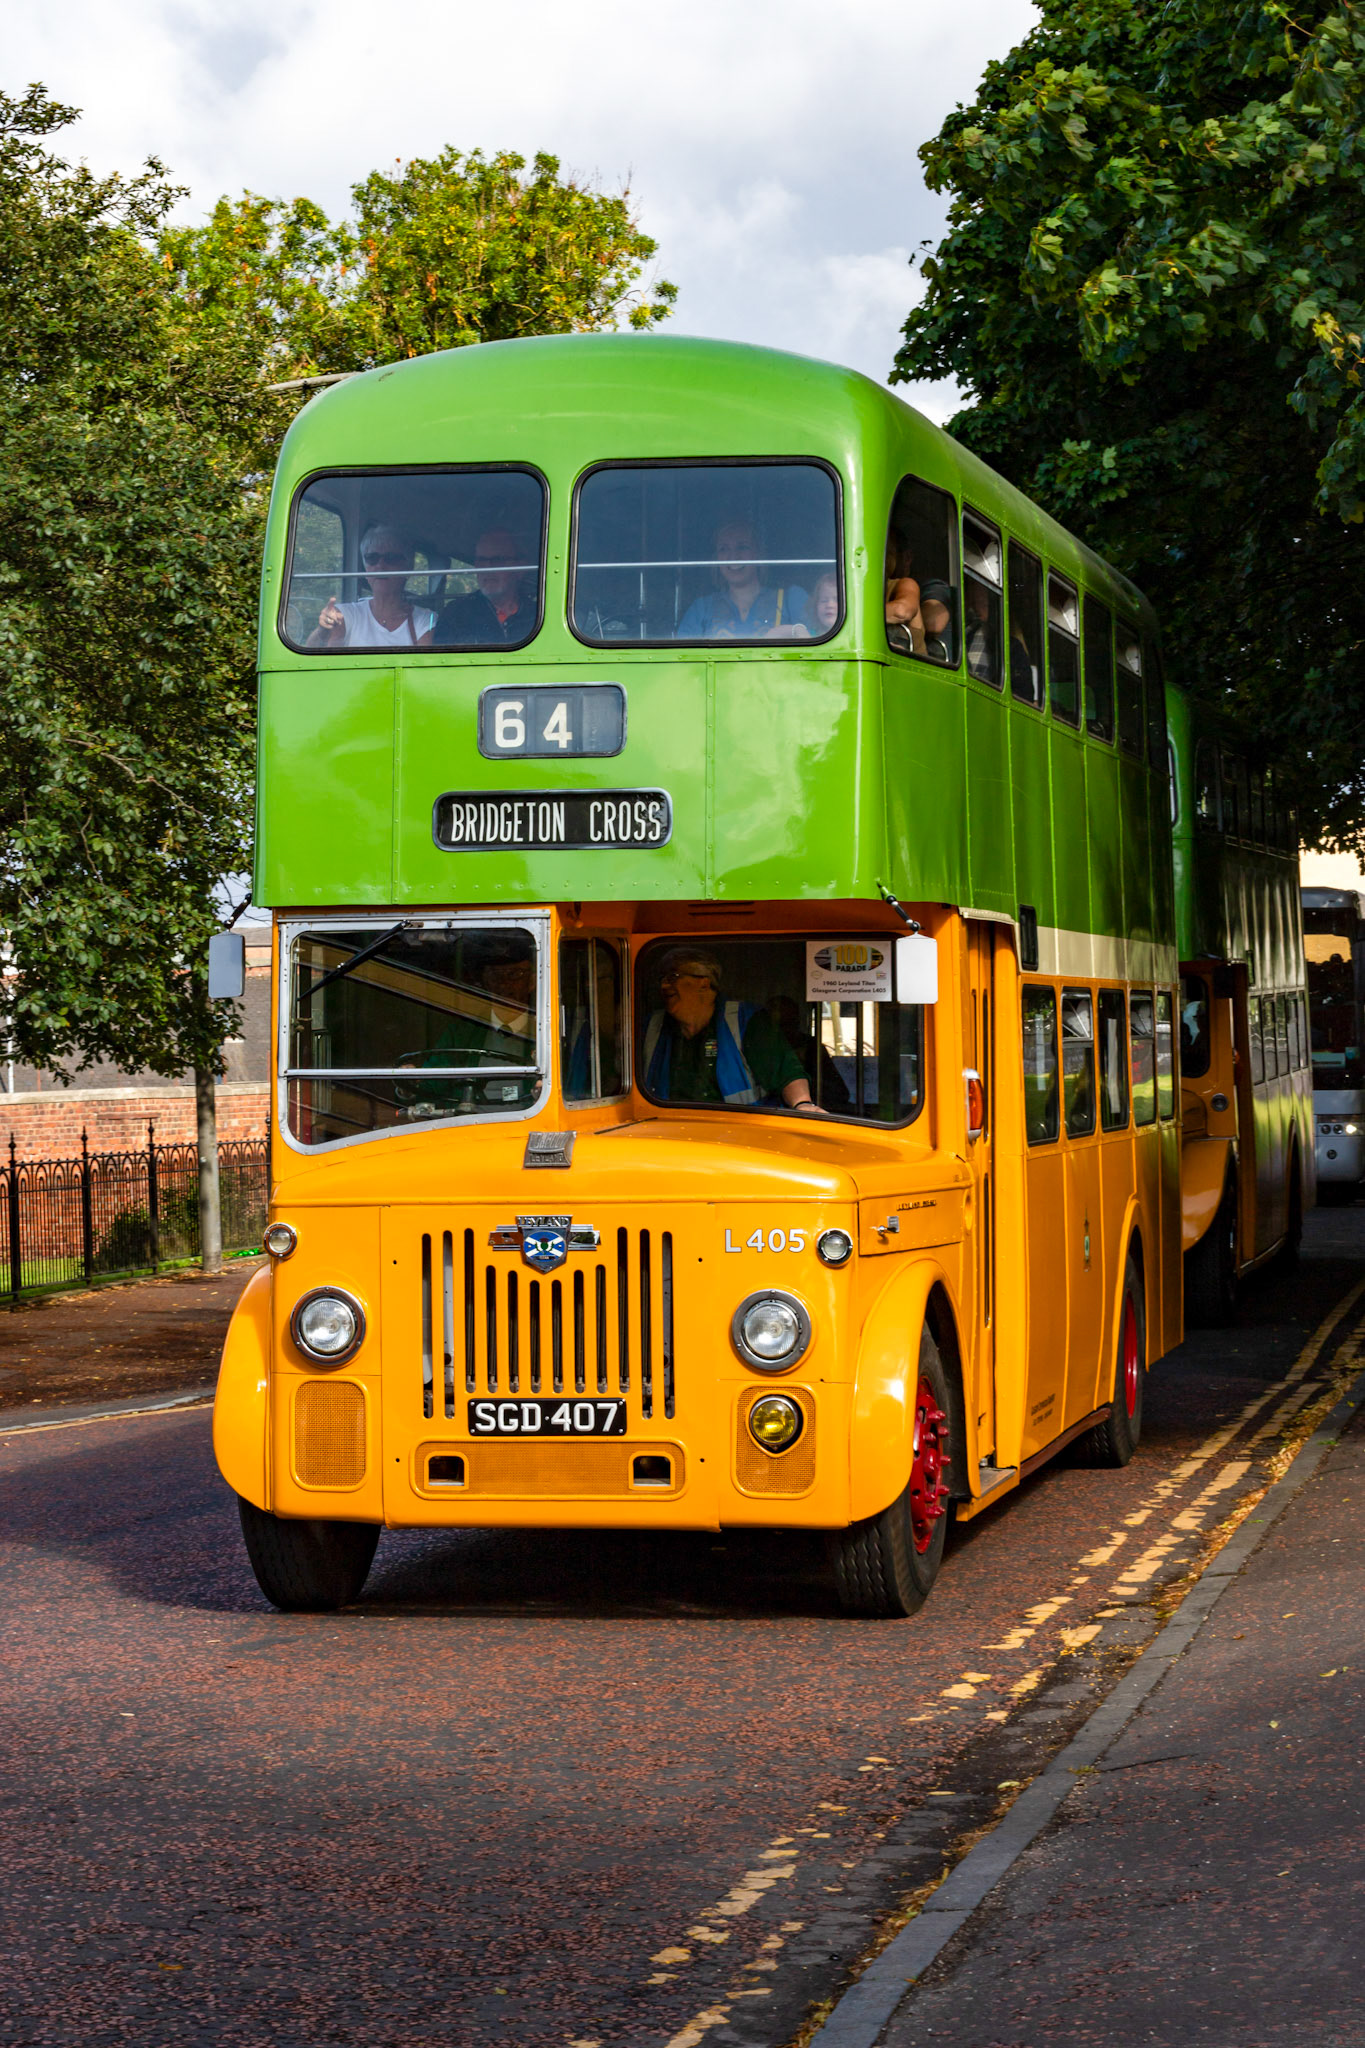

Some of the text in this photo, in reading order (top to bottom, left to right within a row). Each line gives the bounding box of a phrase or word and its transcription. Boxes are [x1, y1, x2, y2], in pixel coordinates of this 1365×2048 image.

[451, 801, 661, 842] BRIDGETON CROSS
[834, 944, 868, 965] 100
[518, 1216, 570, 1227] LEYLAND
